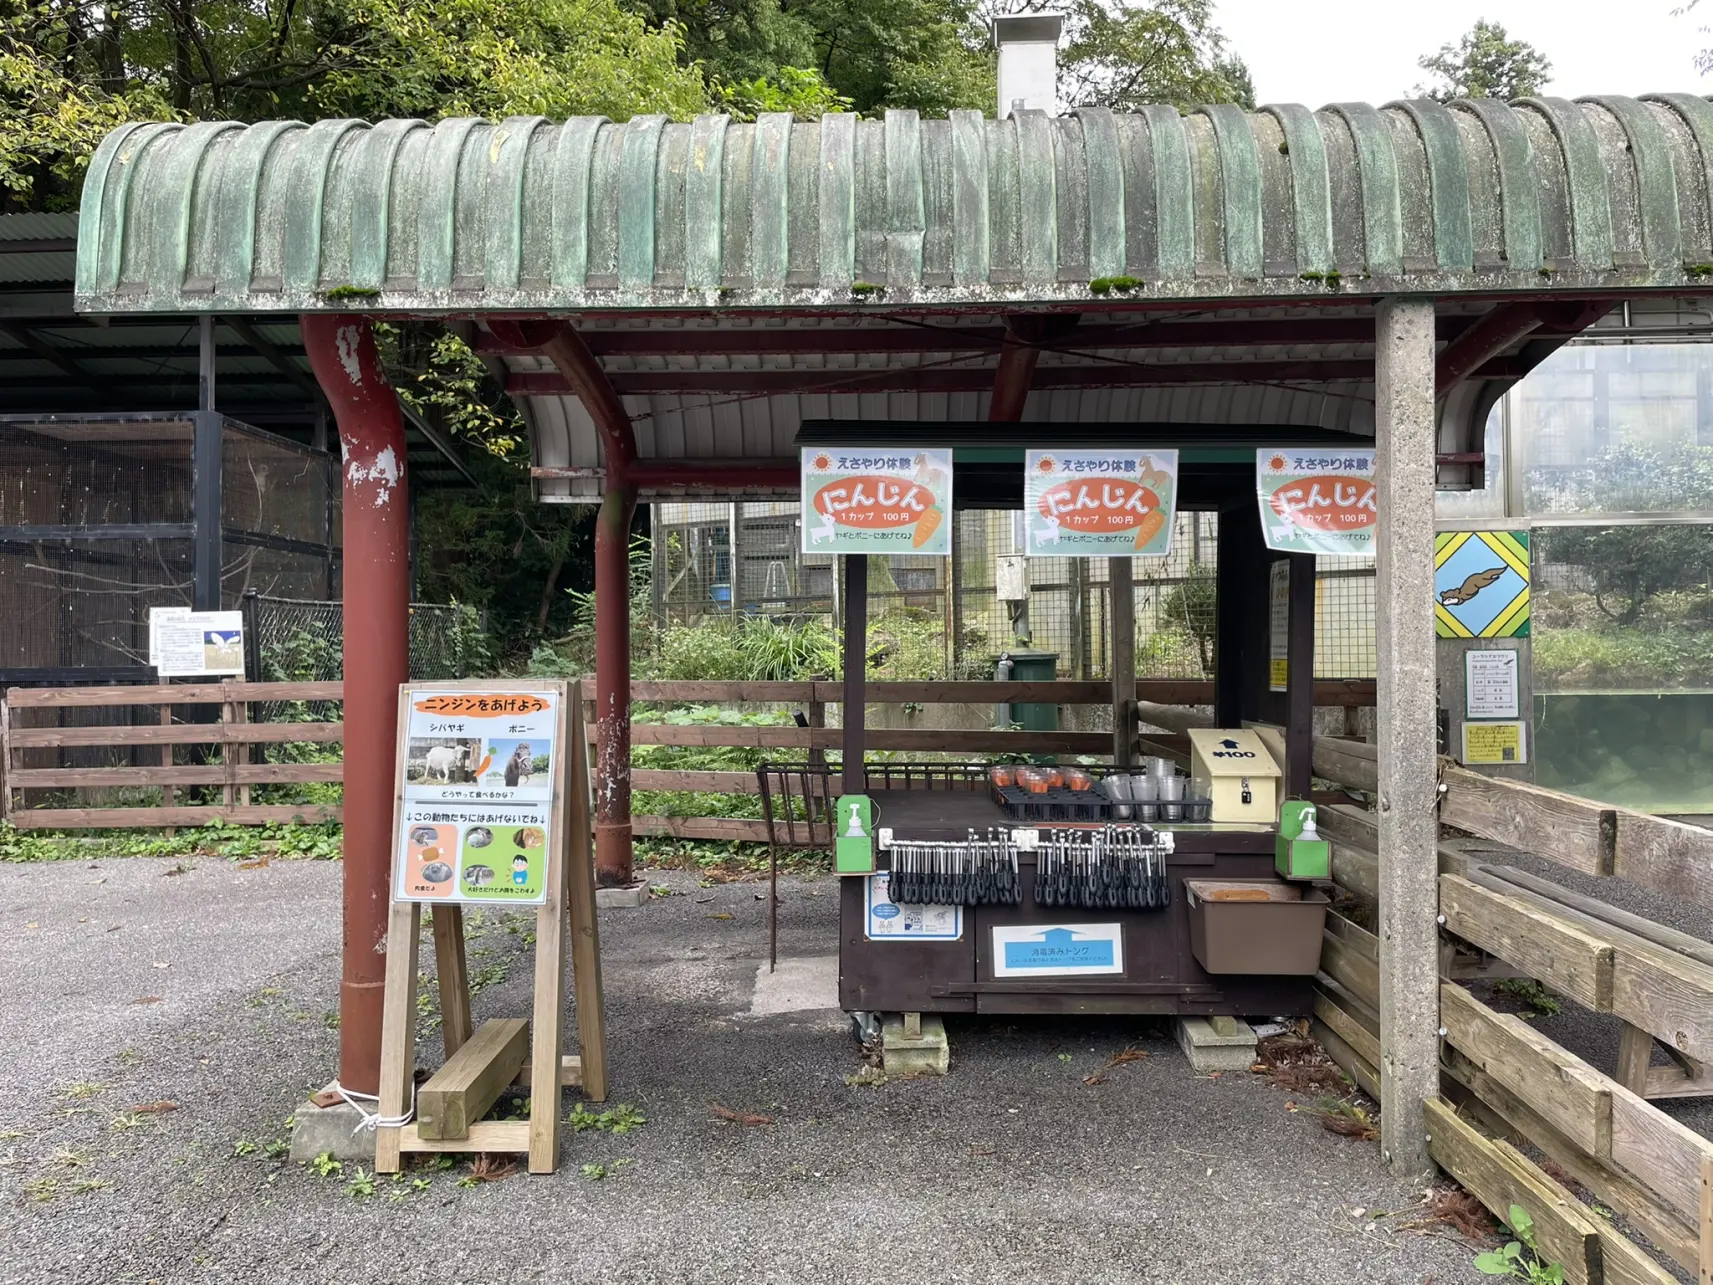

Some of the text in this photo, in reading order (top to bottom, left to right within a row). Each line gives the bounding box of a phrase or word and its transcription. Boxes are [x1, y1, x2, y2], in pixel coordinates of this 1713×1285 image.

[837, 456, 912, 471] えさやり体験
[1061, 459, 1137, 473] えさやり体験
[1293, 457, 1369, 471] えさやり体験
[821, 481, 925, 514] にんじん
[1046, 484, 1150, 516] にんじん
[1278, 482, 1377, 514] にんじん
[882, 512, 910, 522] 100円
[1107, 515, 1135, 525] 100円
[1340, 514, 1368, 523] 100円
[424, 698, 543, 712] ニンジンをあげよう
[429, 723, 465, 733] シバヤギ
[508, 724, 535, 734] ポニー
[1212, 750, 1256, 759] ¥100
[413, 811, 538, 824] この動物たちにはあげないでね
